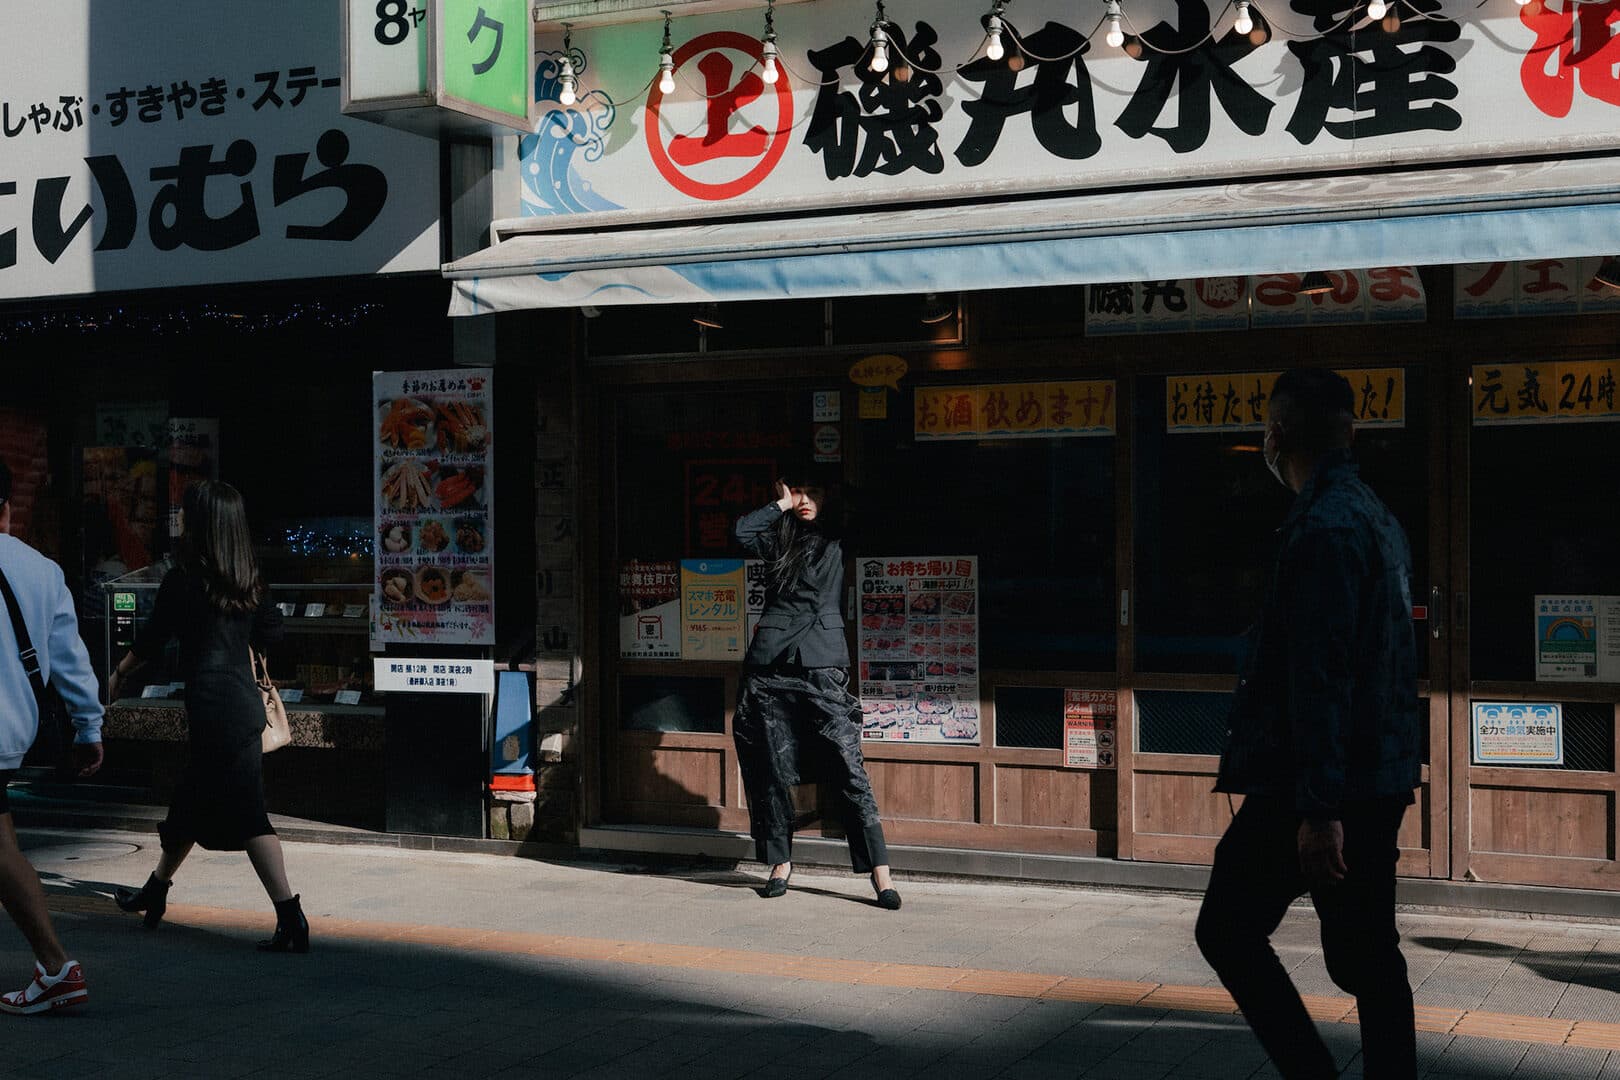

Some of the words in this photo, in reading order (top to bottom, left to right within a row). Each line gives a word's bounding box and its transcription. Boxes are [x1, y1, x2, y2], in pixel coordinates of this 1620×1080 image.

[467, 7, 504, 75] ク
[803, 0, 1462, 180] 磯丸水産
[1172, 375, 1394, 424] お待たせた!
[887, 560, 953, 577] お持ち帰り
[688, 589, 736, 602] スマホ充電
[689, 603, 736, 616] レンタル
